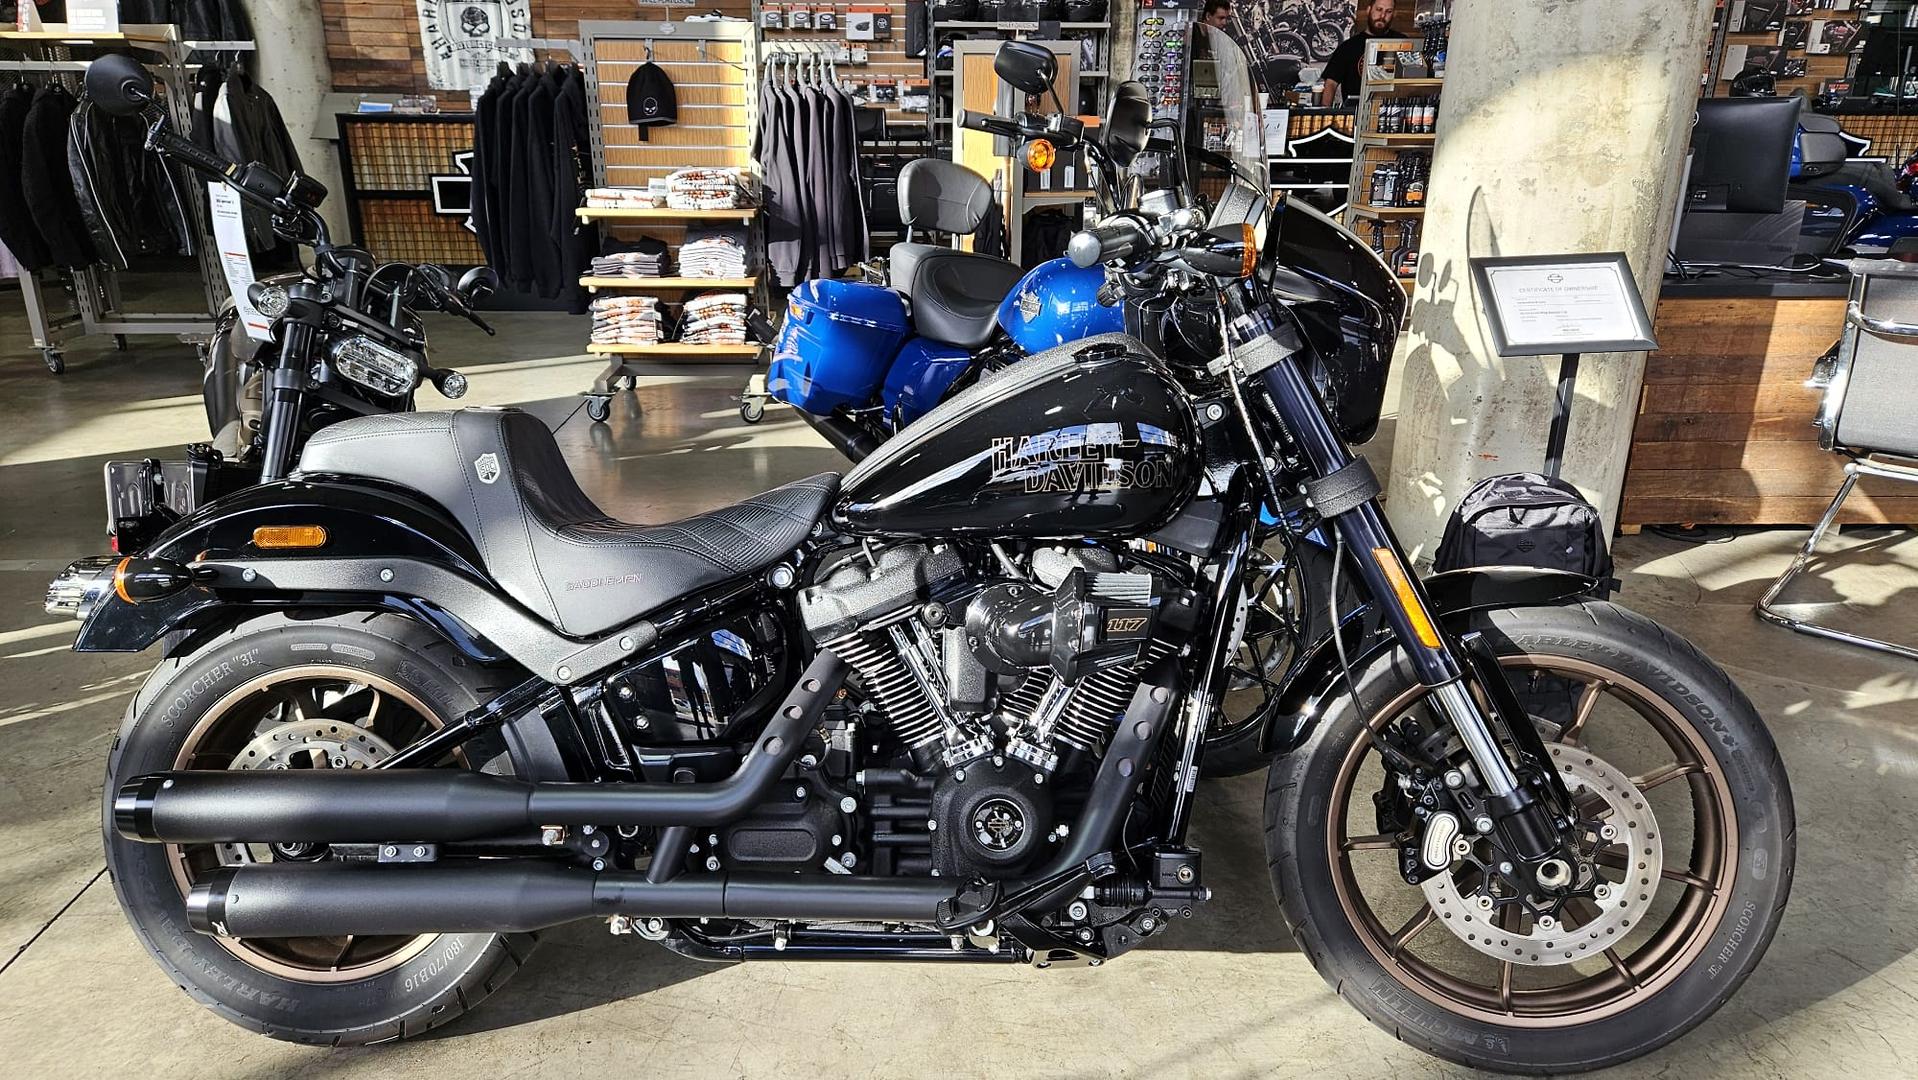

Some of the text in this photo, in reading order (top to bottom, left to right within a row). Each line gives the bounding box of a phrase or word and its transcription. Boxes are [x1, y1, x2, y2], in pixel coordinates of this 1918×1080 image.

[1024, 459, 1174, 493] DAVIDSON
[1106, 617, 1148, 632] 117
[161, 661, 234, 728] SCORCHER
[1717, 901, 1756, 964] SCORCHER
